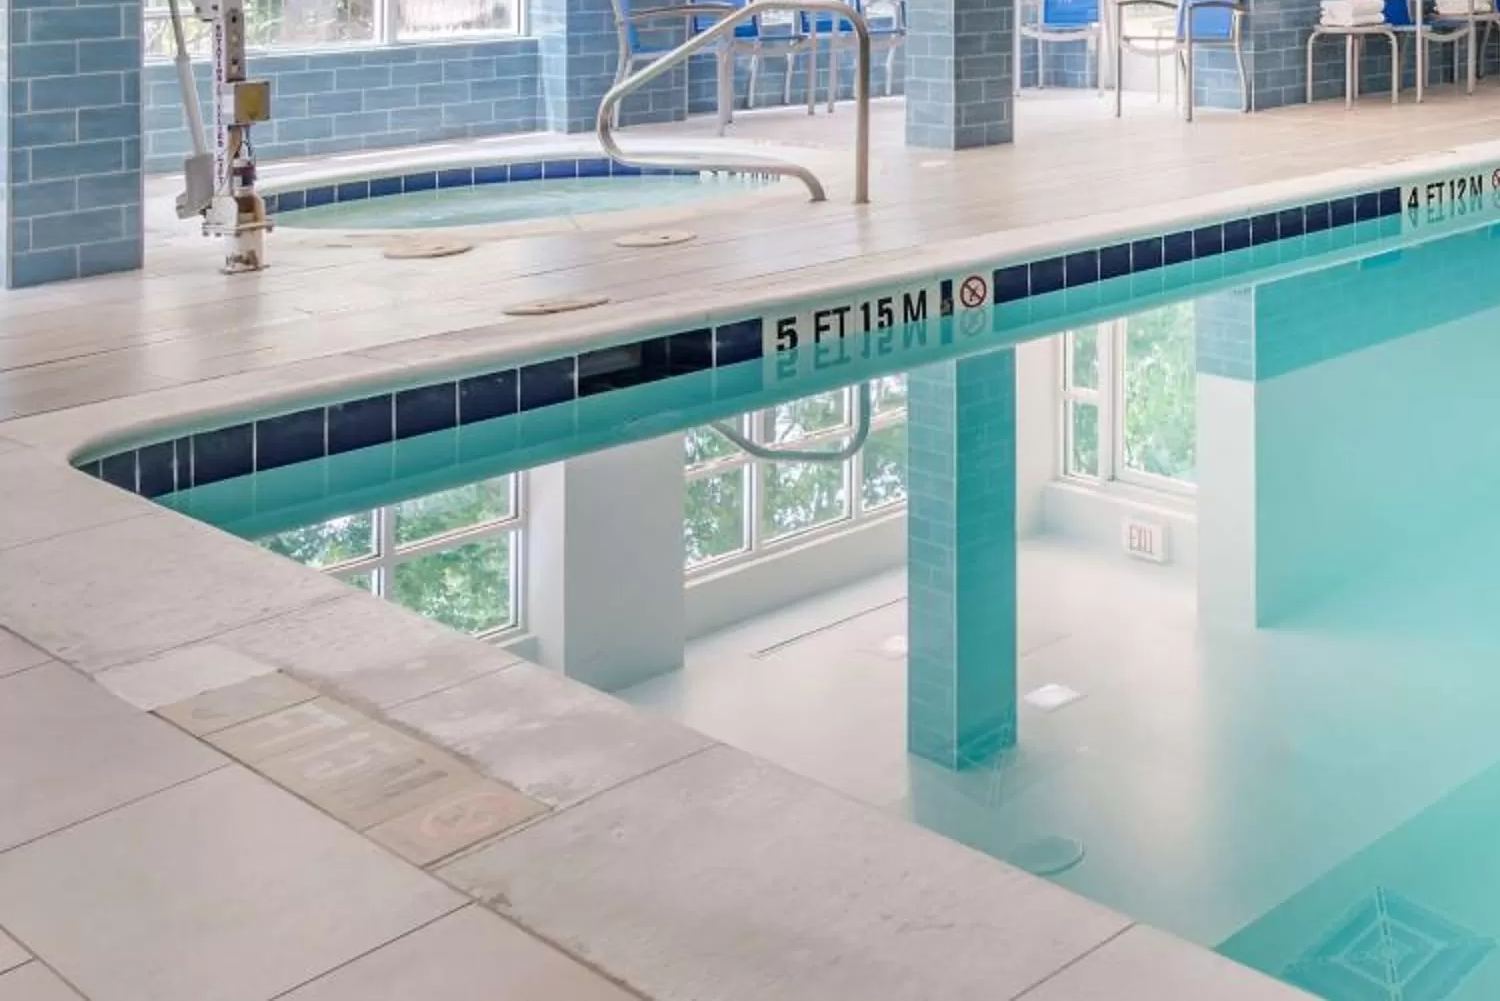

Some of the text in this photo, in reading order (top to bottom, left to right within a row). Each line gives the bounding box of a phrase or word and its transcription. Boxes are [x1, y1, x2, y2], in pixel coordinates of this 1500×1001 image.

[1408, 187, 1419, 208] 4
[1426, 182, 1445, 206] FT
[777, 316, 798, 352] 5
[814, 306, 851, 344] FT
[903, 289, 927, 324] M
